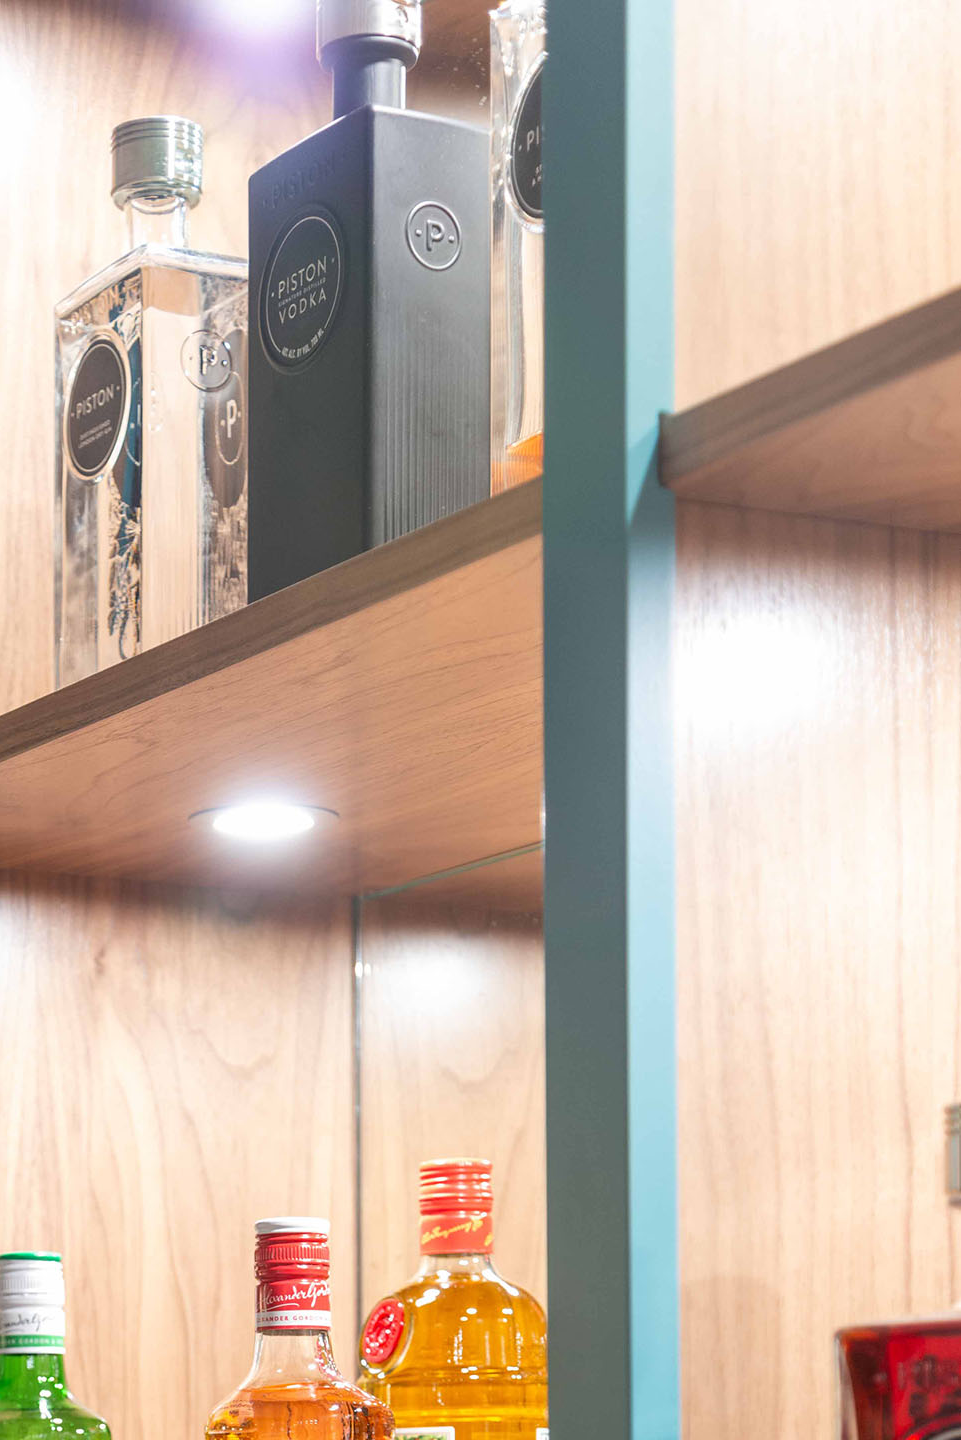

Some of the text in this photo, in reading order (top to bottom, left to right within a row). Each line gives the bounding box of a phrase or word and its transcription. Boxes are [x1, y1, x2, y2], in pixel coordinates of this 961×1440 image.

[525, 125, 544, 152] PI
[426, 219, 445, 252] P
[278, 255, 327, 299] PISTON
[279, 287, 327, 324] VODKA
[75, 384, 114, 419] PISTON
